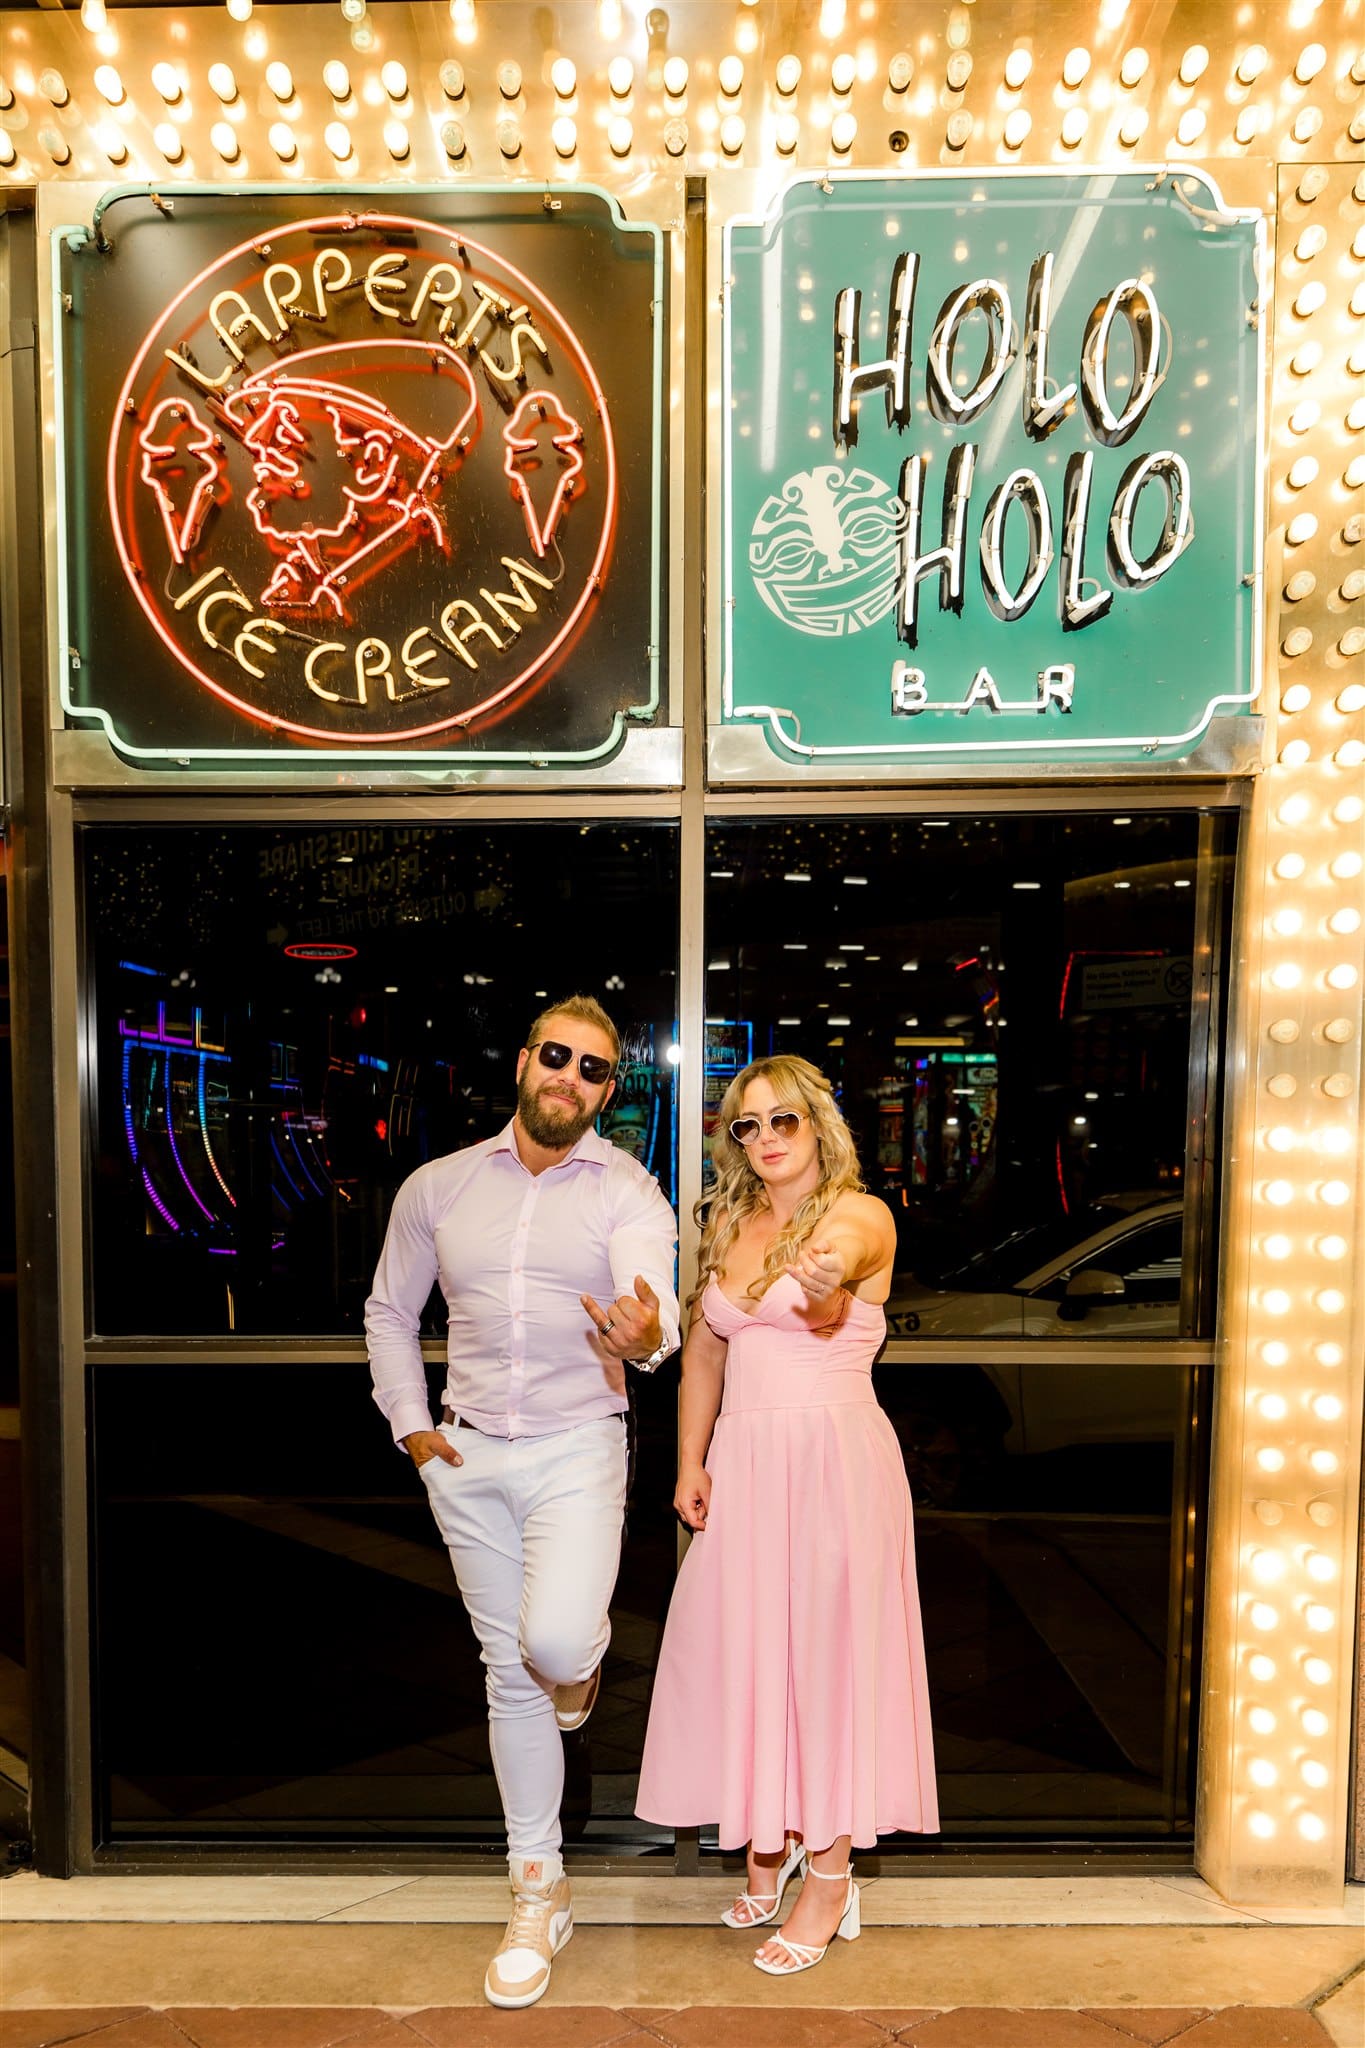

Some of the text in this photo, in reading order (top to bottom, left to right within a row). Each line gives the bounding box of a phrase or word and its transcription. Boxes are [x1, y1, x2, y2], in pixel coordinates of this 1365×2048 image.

[165, 248, 548, 388] LAPPERT'S
[832, 251, 1168, 452] HOLO
[895, 444, 1194, 650] HOLO
[174, 556, 554, 708] ICE CREAM
[891, 660, 1076, 716] BAR
